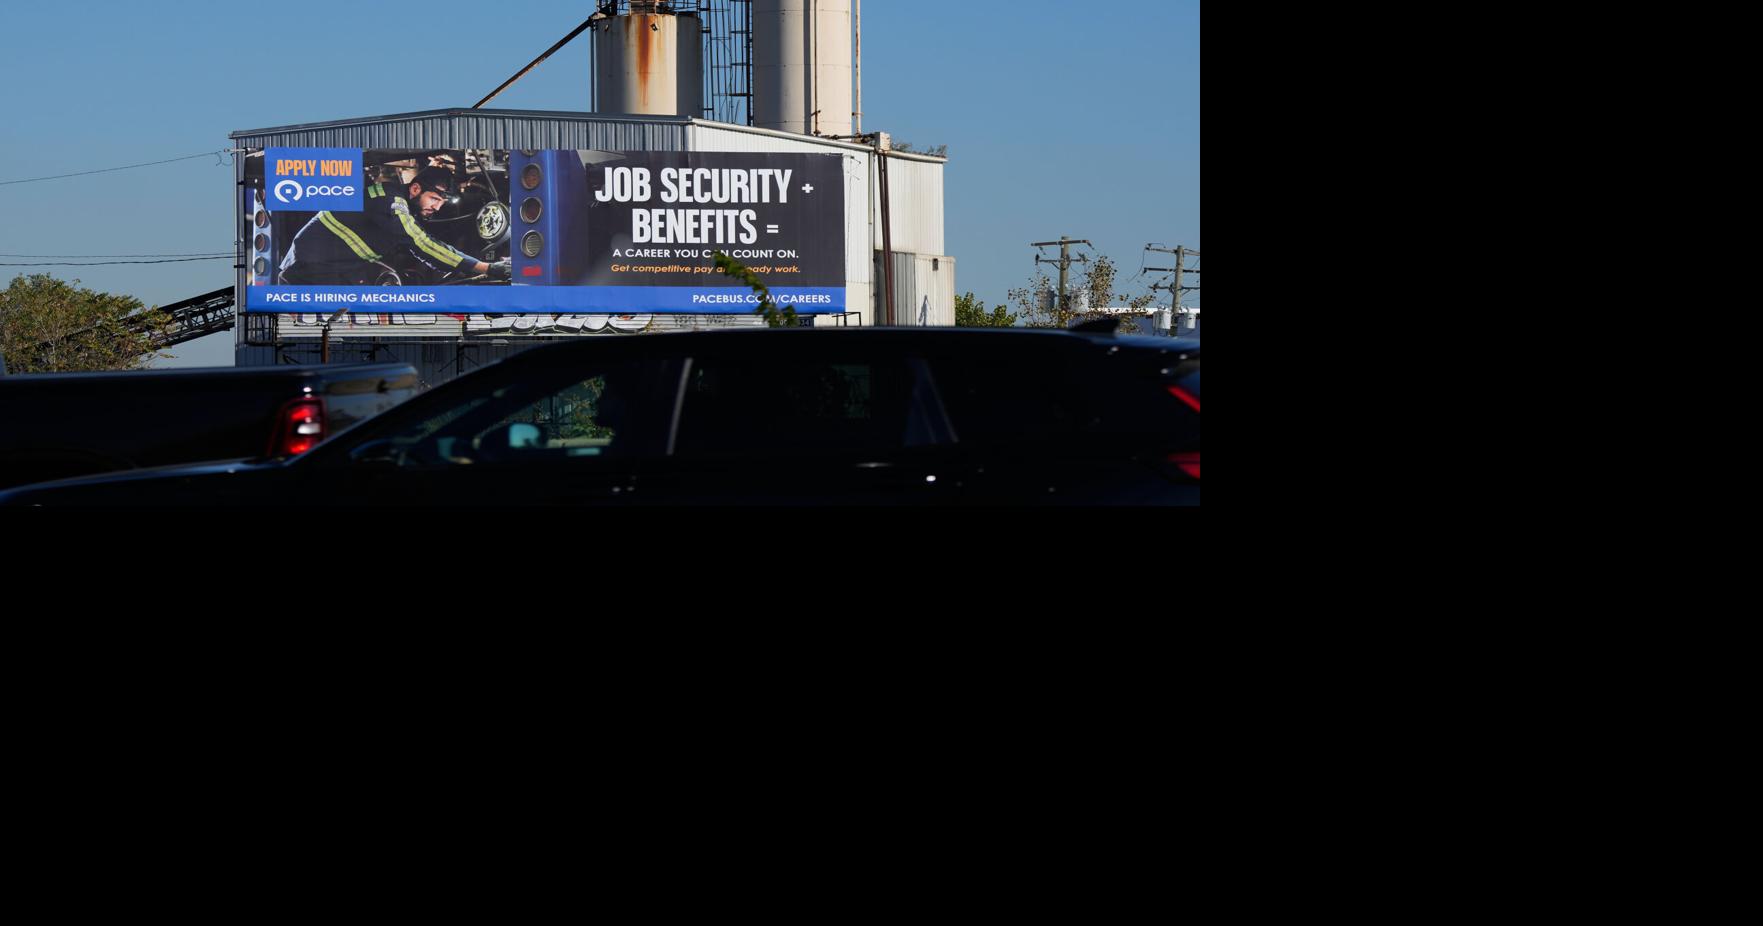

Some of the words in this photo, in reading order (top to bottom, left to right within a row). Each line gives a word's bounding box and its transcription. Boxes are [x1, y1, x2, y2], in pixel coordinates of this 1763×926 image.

[277, 160, 315, 176] APPLY
[321, 161, 352, 175] NOW
[595, 166, 651, 202] JOB
[661, 168, 792, 203] SECURITY
[802, 184, 813, 194] +
[306, 186, 354, 197] pace
[632, 209, 757, 244] BENEFITS
[613, 249, 621, 258] A
[625, 249, 670, 258] CAREER
[674, 250, 698, 258] YOU
[702, 249, 729, 258] CN
[733, 250, 773, 259] COUNT
[777, 249, 799, 258] ON.
[611, 264, 630, 273] Get
[632, 264, 691, 274] competitive
[693, 265, 713, 274] pay
[740, 264, 772, 274] eady
[775, 264, 801, 273] work.
[267, 294, 297, 302] PACE
[301, 294, 311, 303] IS
[315, 294, 357, 303] HIRING
[361, 294, 435, 303] MECHANICS
[692, 294, 832, 304] PACEBUS.COM/CAREERS
